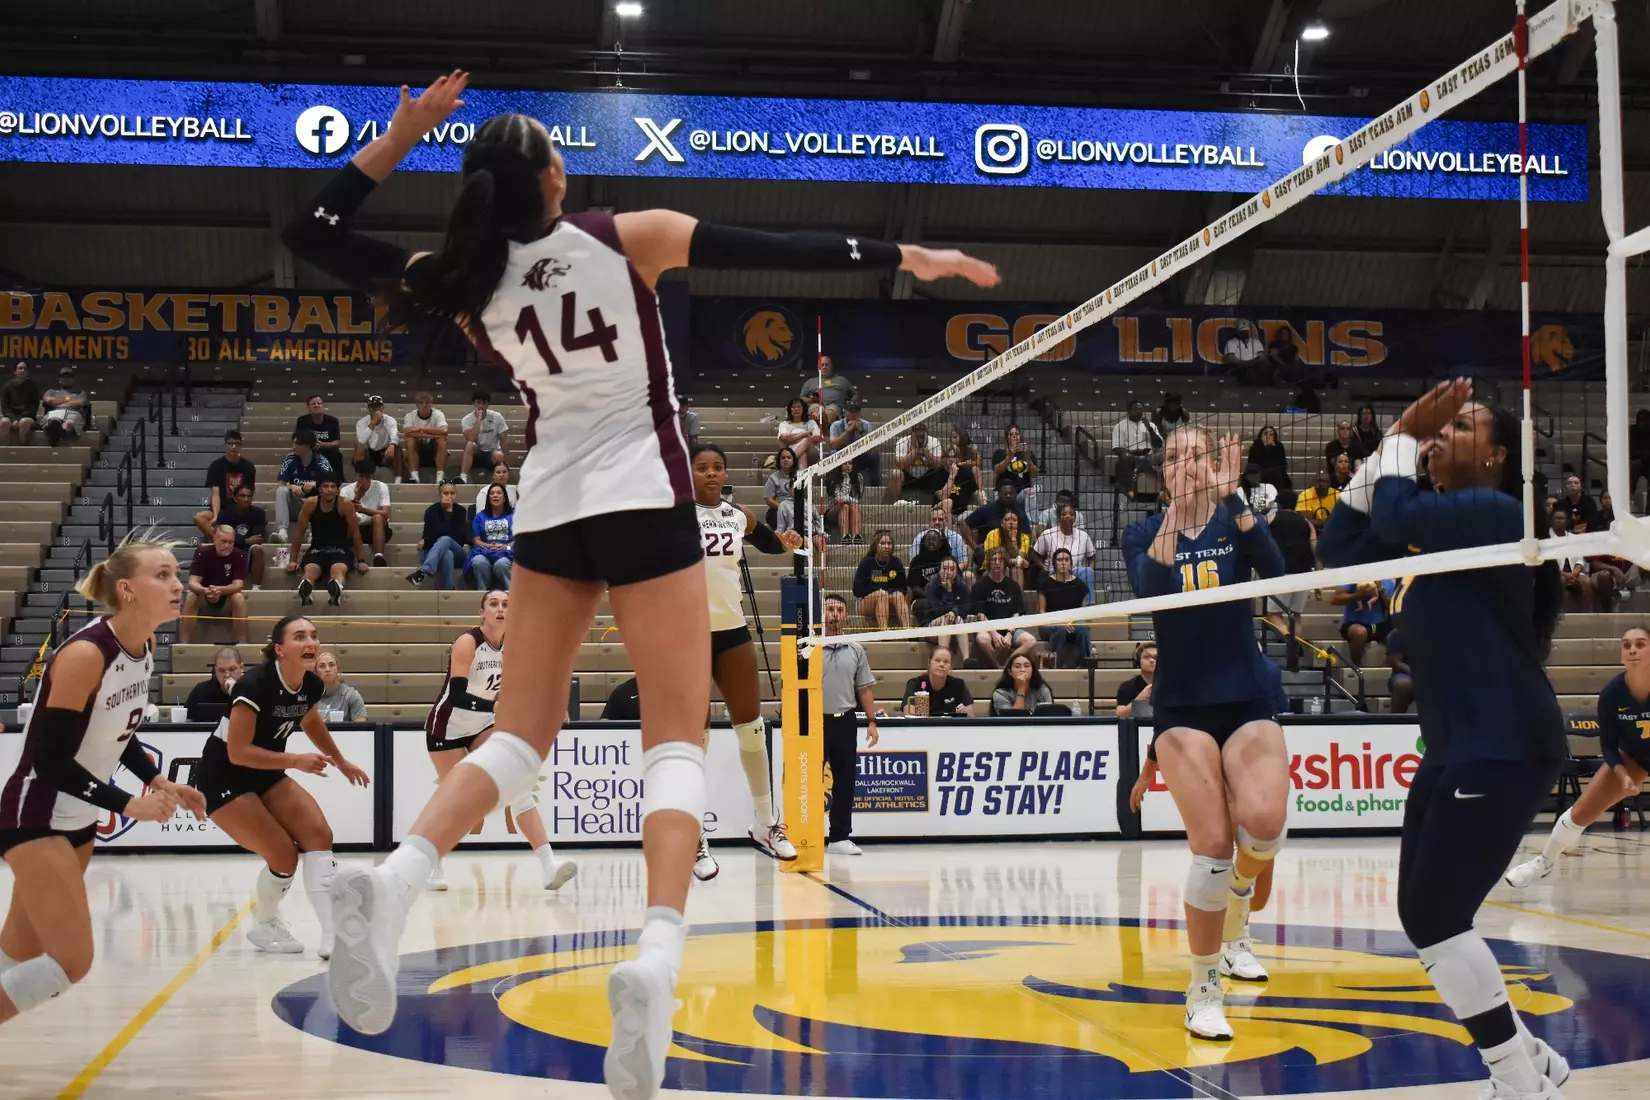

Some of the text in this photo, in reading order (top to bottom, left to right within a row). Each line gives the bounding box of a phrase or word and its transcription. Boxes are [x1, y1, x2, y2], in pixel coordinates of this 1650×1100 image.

[1461, 53, 1491, 84] TEXAS
[0, 111, 252, 139] @LIONVOLLEYBALL
[1368, 115, 1395, 140] TEXAS
[690, 129, 944, 157] @LION_VOLLEYBALL
[1036, 139, 1264, 167] @LIONVOLLEYBALL
[1357, 149, 1568, 175] LIONVOLLEYBALL
[0, 290, 408, 334] BASKETBALL
[514, 291, 619, 375] 14
[945, 313, 1077, 362] GO
[1113, 316, 1388, 367] LIONS
[218, 337, 393, 363] ALL-AMERICANS
[705, 532, 734, 557] 22
[1175, 544, 1234, 561] ST TEXAS
[1180, 560, 1220, 592] 16
[485, 674, 502, 691] 12
[117, 707, 144, 742] 9
[553, 737, 631, 766] Hunt
[799, 752, 808, 783] sports
[935, 750, 1110, 783] BEST PLACE
[875, 801, 926, 809] ATHLETICS
[938, 784, 1064, 816] TO STAY!
[1296, 793, 1408, 817] food & phar
